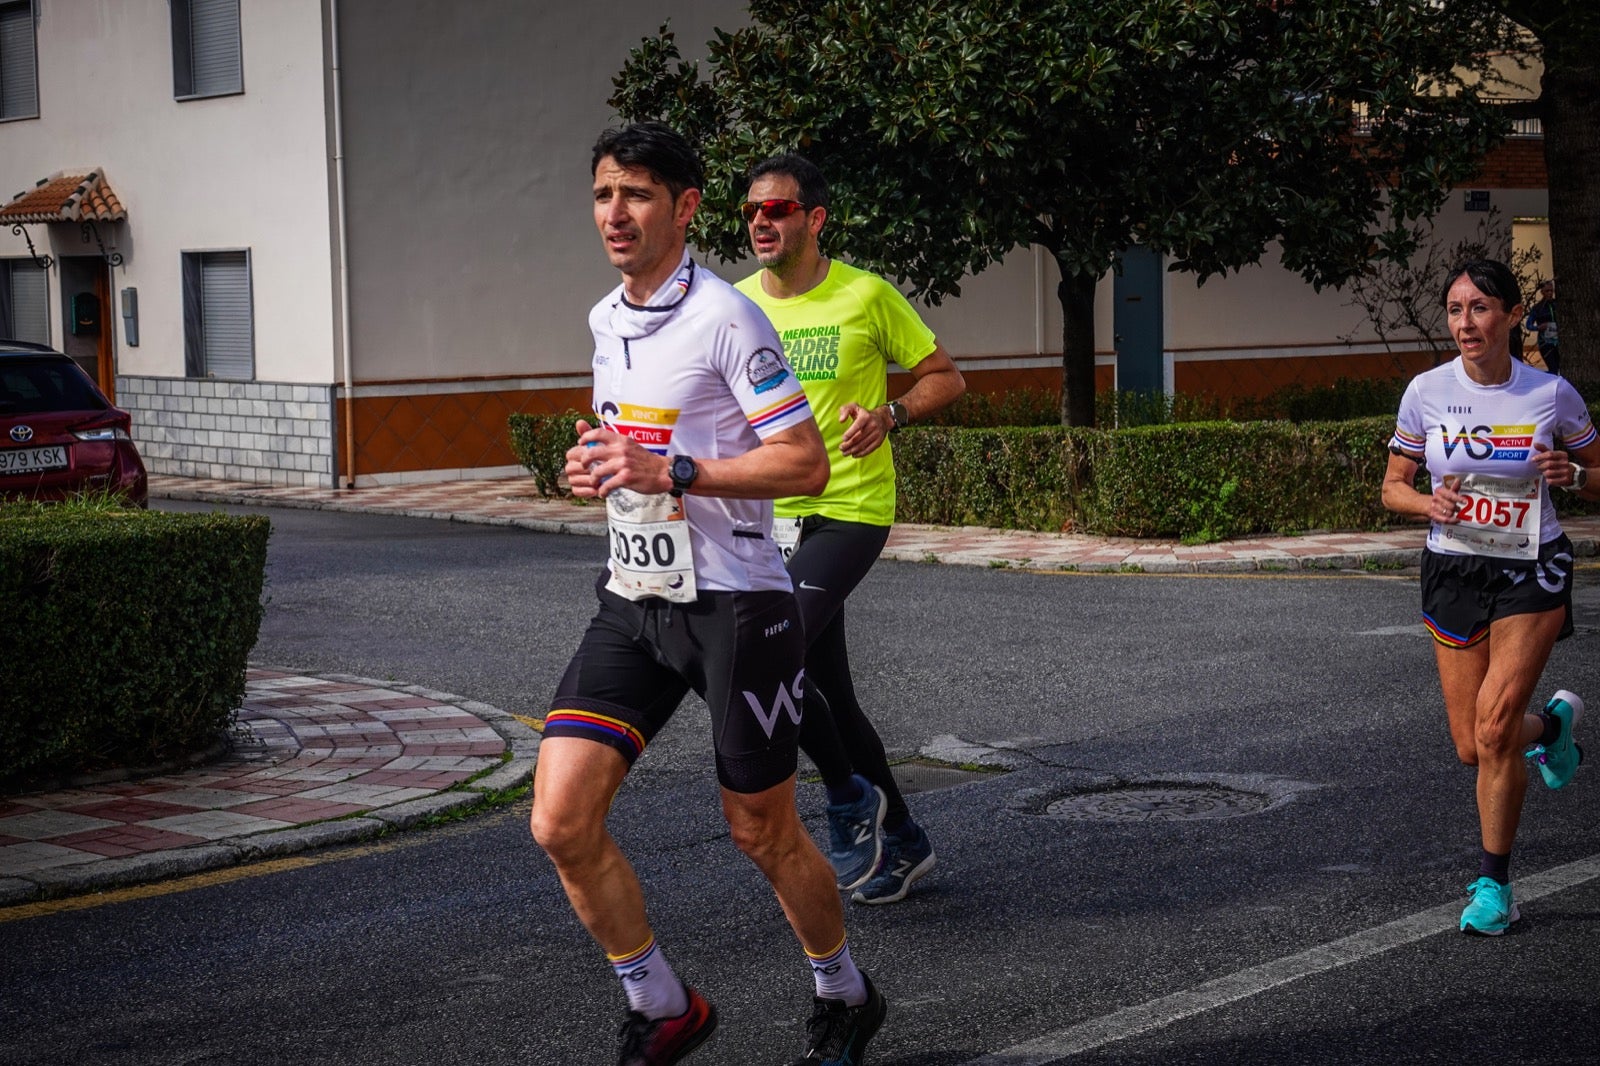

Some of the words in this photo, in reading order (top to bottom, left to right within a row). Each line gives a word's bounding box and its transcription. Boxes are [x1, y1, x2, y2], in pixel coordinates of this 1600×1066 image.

[783, 325, 841, 340] MEMORIAL
[781, 337, 840, 357] PADRE
[788, 354, 839, 372] ELINO
[796, 371, 836, 381] RANADA
[631, 409, 659, 421] VINCI
[628, 430, 663, 442] ACTIVE
[1500, 438, 1526, 446] ACTIVE
[32, 448, 63, 466] KSK
[1498, 451, 1523, 459] SPORT
[1456, 494, 1530, 529] 2057
